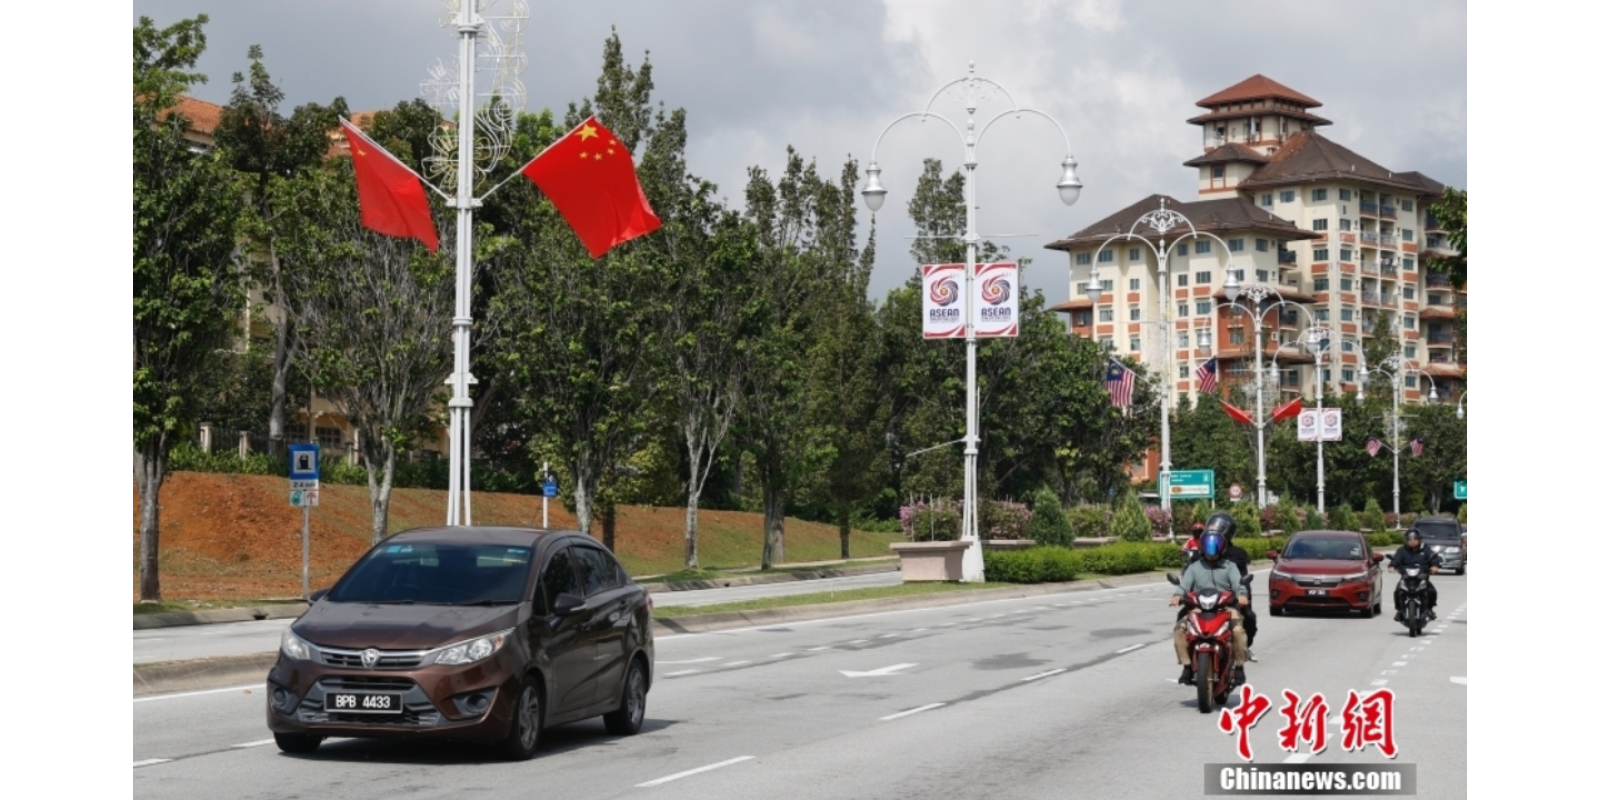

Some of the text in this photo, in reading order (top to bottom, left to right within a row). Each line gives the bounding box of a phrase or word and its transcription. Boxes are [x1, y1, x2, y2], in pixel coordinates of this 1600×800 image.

[930, 308, 960, 318] ASEAN
[981, 307, 1011, 317] ASEAN
[336, 695, 391, 709] BPB 4433
